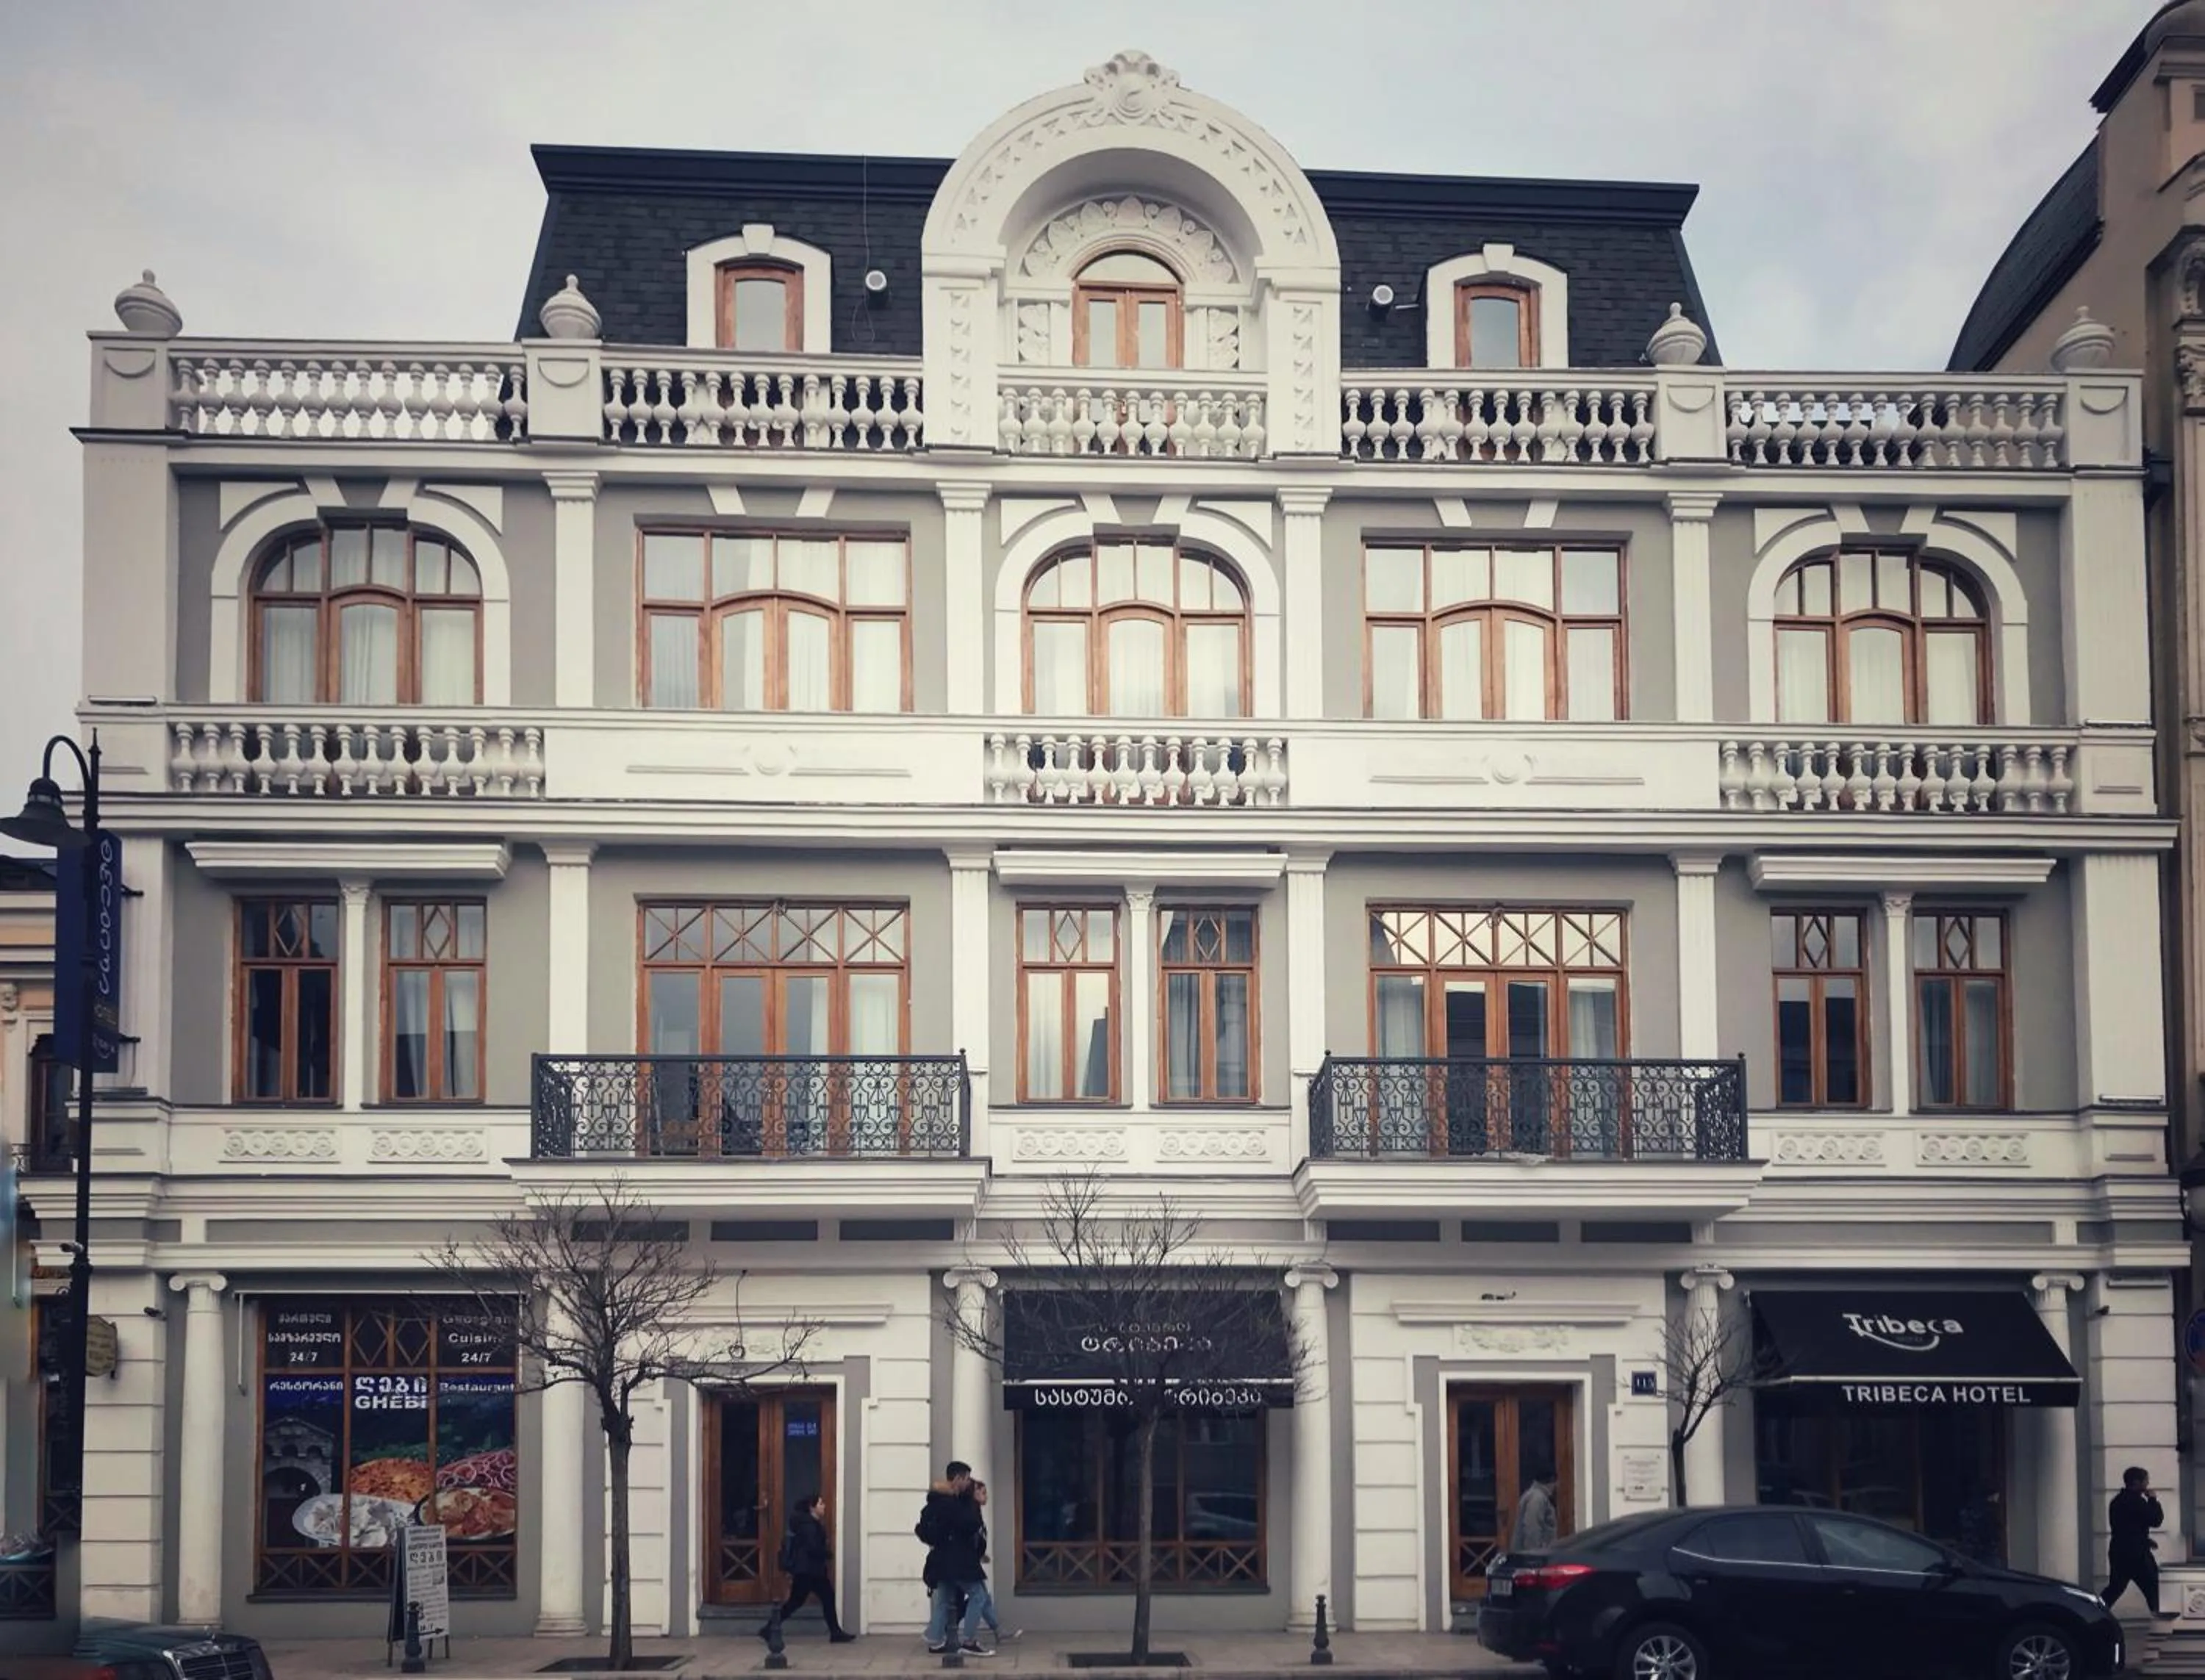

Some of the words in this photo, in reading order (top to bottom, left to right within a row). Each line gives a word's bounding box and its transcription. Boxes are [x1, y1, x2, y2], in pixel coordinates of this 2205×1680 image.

[1843, 1313, 1964, 1339] Tribeca
[290, 1351, 318, 1363] 24/7
[462, 1352, 492, 1363] 24/7
[269, 1381, 344, 1391] რესტორანი
[355, 1376, 427, 1393] ღები
[1843, 1385, 1946, 1403] TRIBECA
[1953, 1386, 2031, 1404] HOTEL
[355, 1396, 427, 1410] GHEBI
